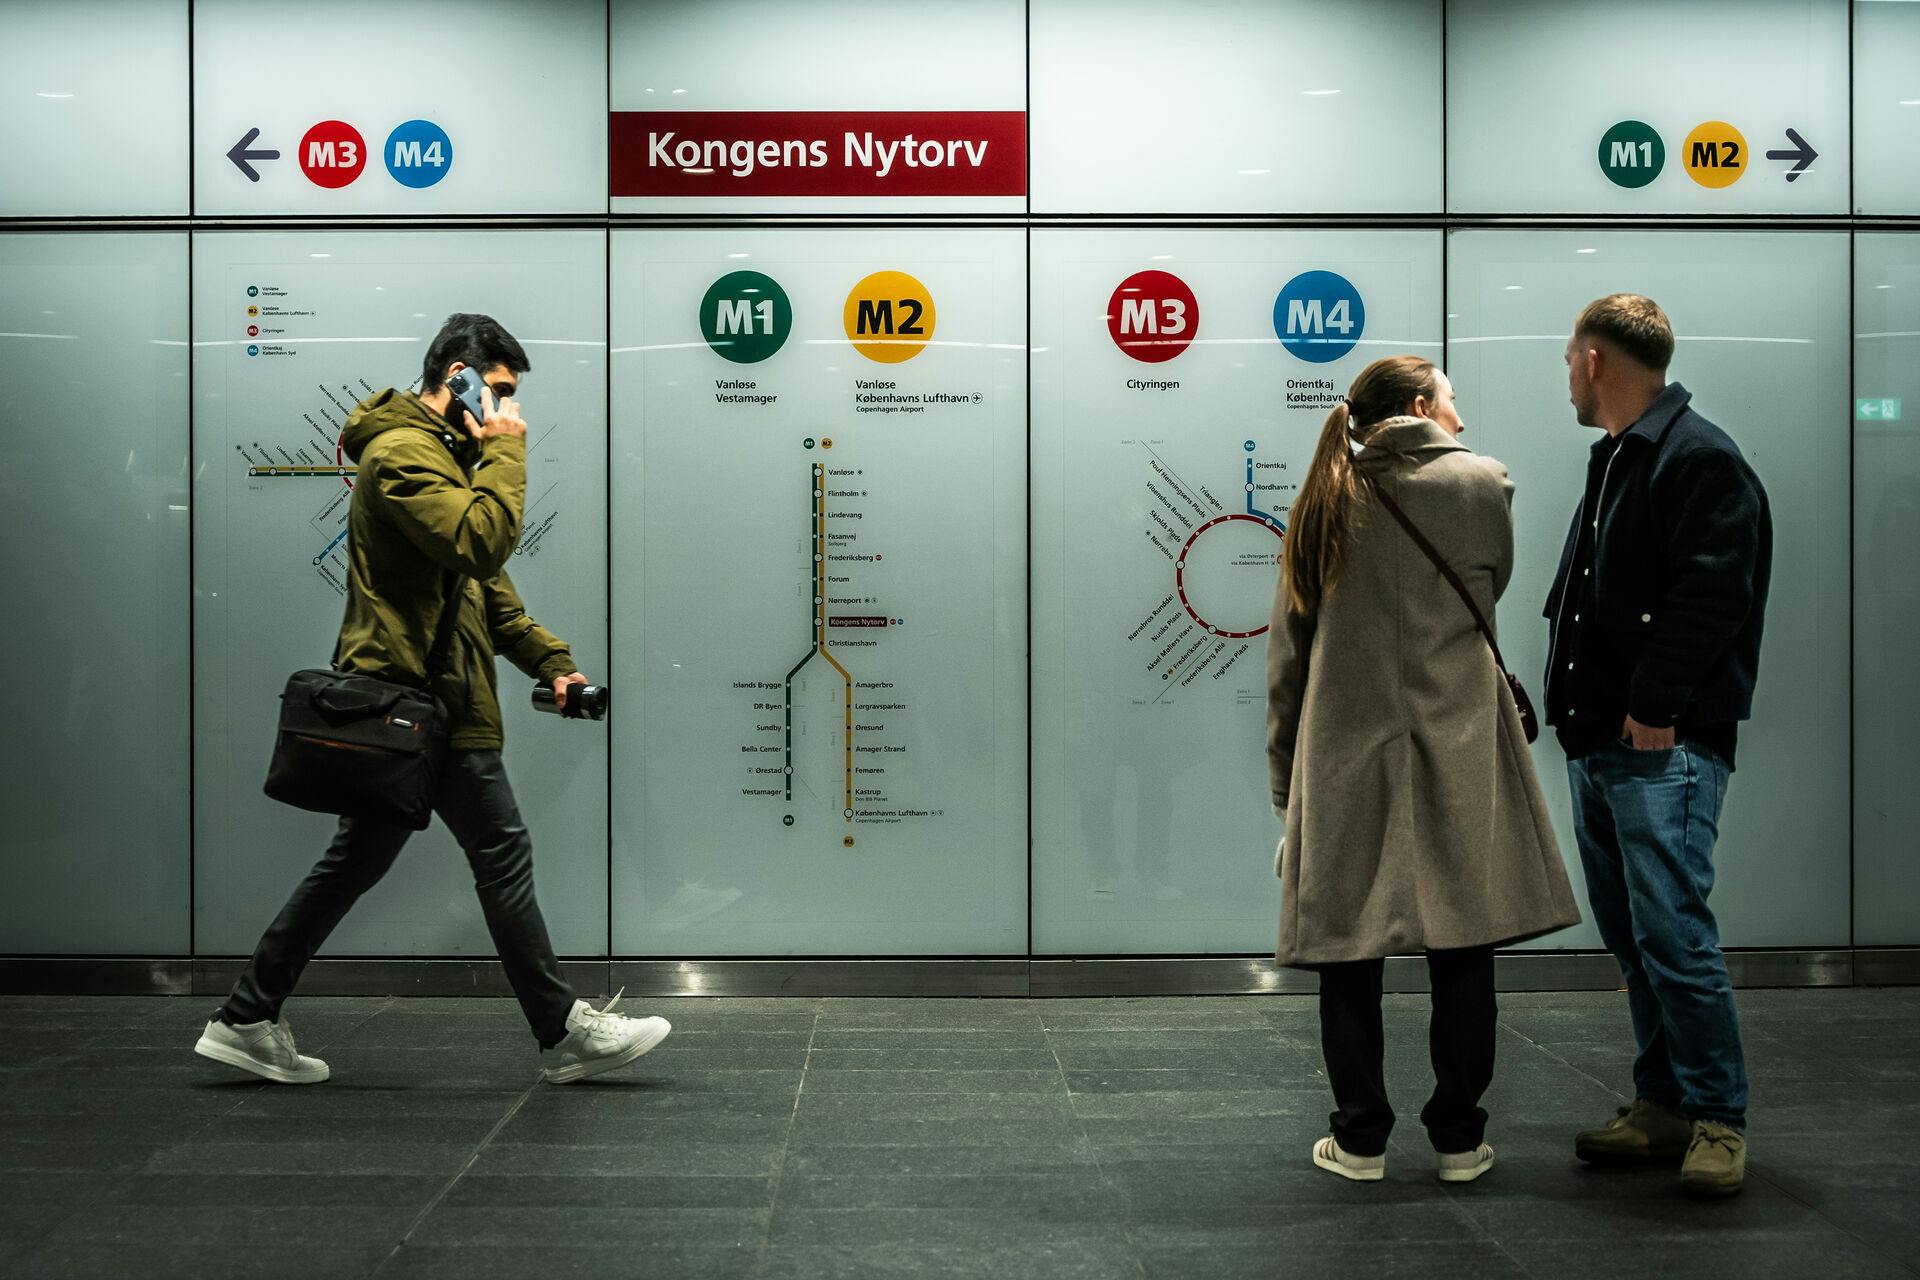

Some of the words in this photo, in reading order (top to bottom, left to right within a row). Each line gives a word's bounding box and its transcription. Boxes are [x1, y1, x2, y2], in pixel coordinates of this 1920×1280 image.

[308, 141, 358, 168] M3
[394, 142, 445, 168] M4
[648, 132, 828, 177] Kongens
[844, 132, 988, 177] Nytorv
[1610, 142, 1652, 168] M1
[1691, 142, 1740, 168] M2
[716, 300, 774, 335] M1
[856, 299, 924, 334] M2
[1120, 298, 1186, 334] M3
[1286, 300, 1354, 334] M4
[716, 380, 756, 390] Vanløse
[856, 380, 896, 390] Vanløse
[1126, 379, 1180, 391] Cityringen
[1286, 379, 1334, 391] Orientkaj
[1286, 392, 1345, 402] København
[716, 393, 778, 405] Vestamager
[856, 392, 920, 403] Københavns
[923, 392, 969, 403] Lufthavn
[309, 439, 333, 465] Frederiksberg
[1150, 460, 1163, 473] Poul
[1160, 471, 1192, 504] Henningsens
[1191, 502, 1206, 518] Plads
[1199, 486, 1223, 511] Trianglen
[319, 497, 344, 521] Frederiksberg
[1146, 481, 1172, 507] Vibenshus
[1170, 506, 1193, 530] Runddel
[828, 533, 856, 541] Fasanvej
[1150, 510, 1168, 530] Skjolds
[1166, 526, 1181, 543] Plads
[828, 554, 873, 563] Frederiksberg
[1150, 535, 1174, 560] Nørrebro
[828, 597, 861, 605] Nørreport
[830, 618, 860, 627] Kongens
[862, 618, 885, 626] Nytorv
[1128, 615, 1154, 642] Nørrebros
[1152, 594, 1174, 617] Runddel
[1151, 625, 1168, 643] Nuuks
[1166, 611, 1182, 627] Plads
[1146, 655, 1162, 672] Aksel
[1160, 636, 1180, 658] Møllers
[1179, 624, 1194, 639] Have
[1173, 634, 1208, 670] Frederiksberg
[1181, 652, 1217, 687] Frederiksberg
[1214, 641, 1226, 655] Allé
[1212, 657, 1235, 681] Enghave
[1233, 643, 1249, 660] Plads
[758, 682, 782, 690] Brygge
[855, 682, 893, 690] Amagerbro
[765, 703, 782, 711] Byen
[855, 703, 906, 711] Lergravsparken
[756, 724, 782, 732] Sundby
[855, 746, 882, 754] Amager
[742, 788, 782, 797] Vestamager
